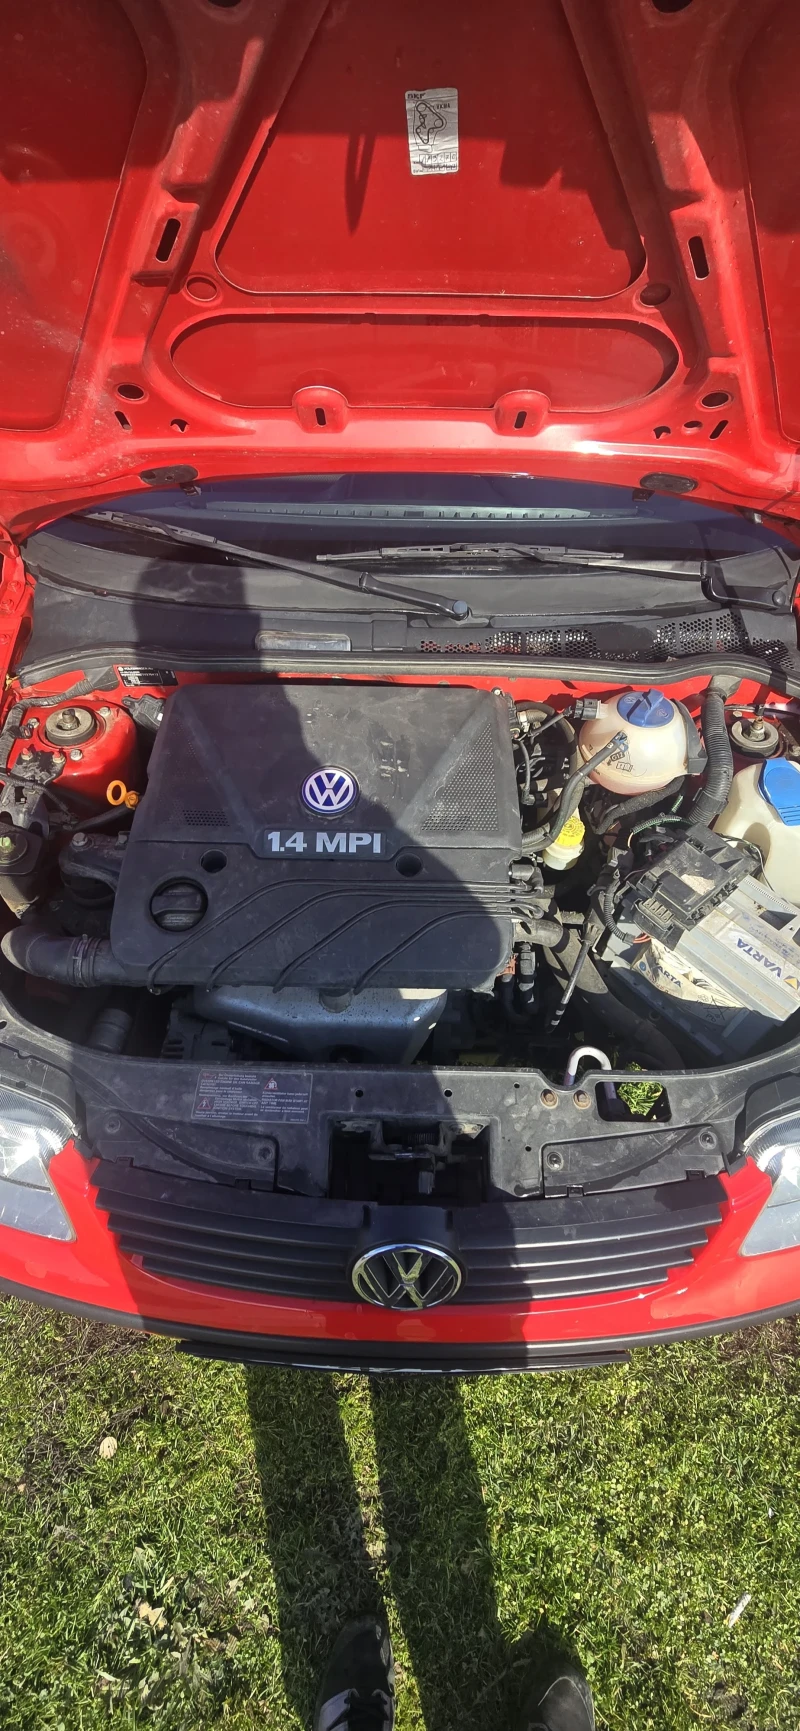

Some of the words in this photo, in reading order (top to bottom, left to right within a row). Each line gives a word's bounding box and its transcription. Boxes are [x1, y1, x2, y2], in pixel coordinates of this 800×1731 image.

[304, 769, 355, 811] VW
[267, 831, 308, 853] 1.4
[315, 831, 382, 854] MPI
[654, 963, 683, 989] ARTA
[736, 937, 784, 979] VARTA
[352, 1244, 461, 1311] VW
